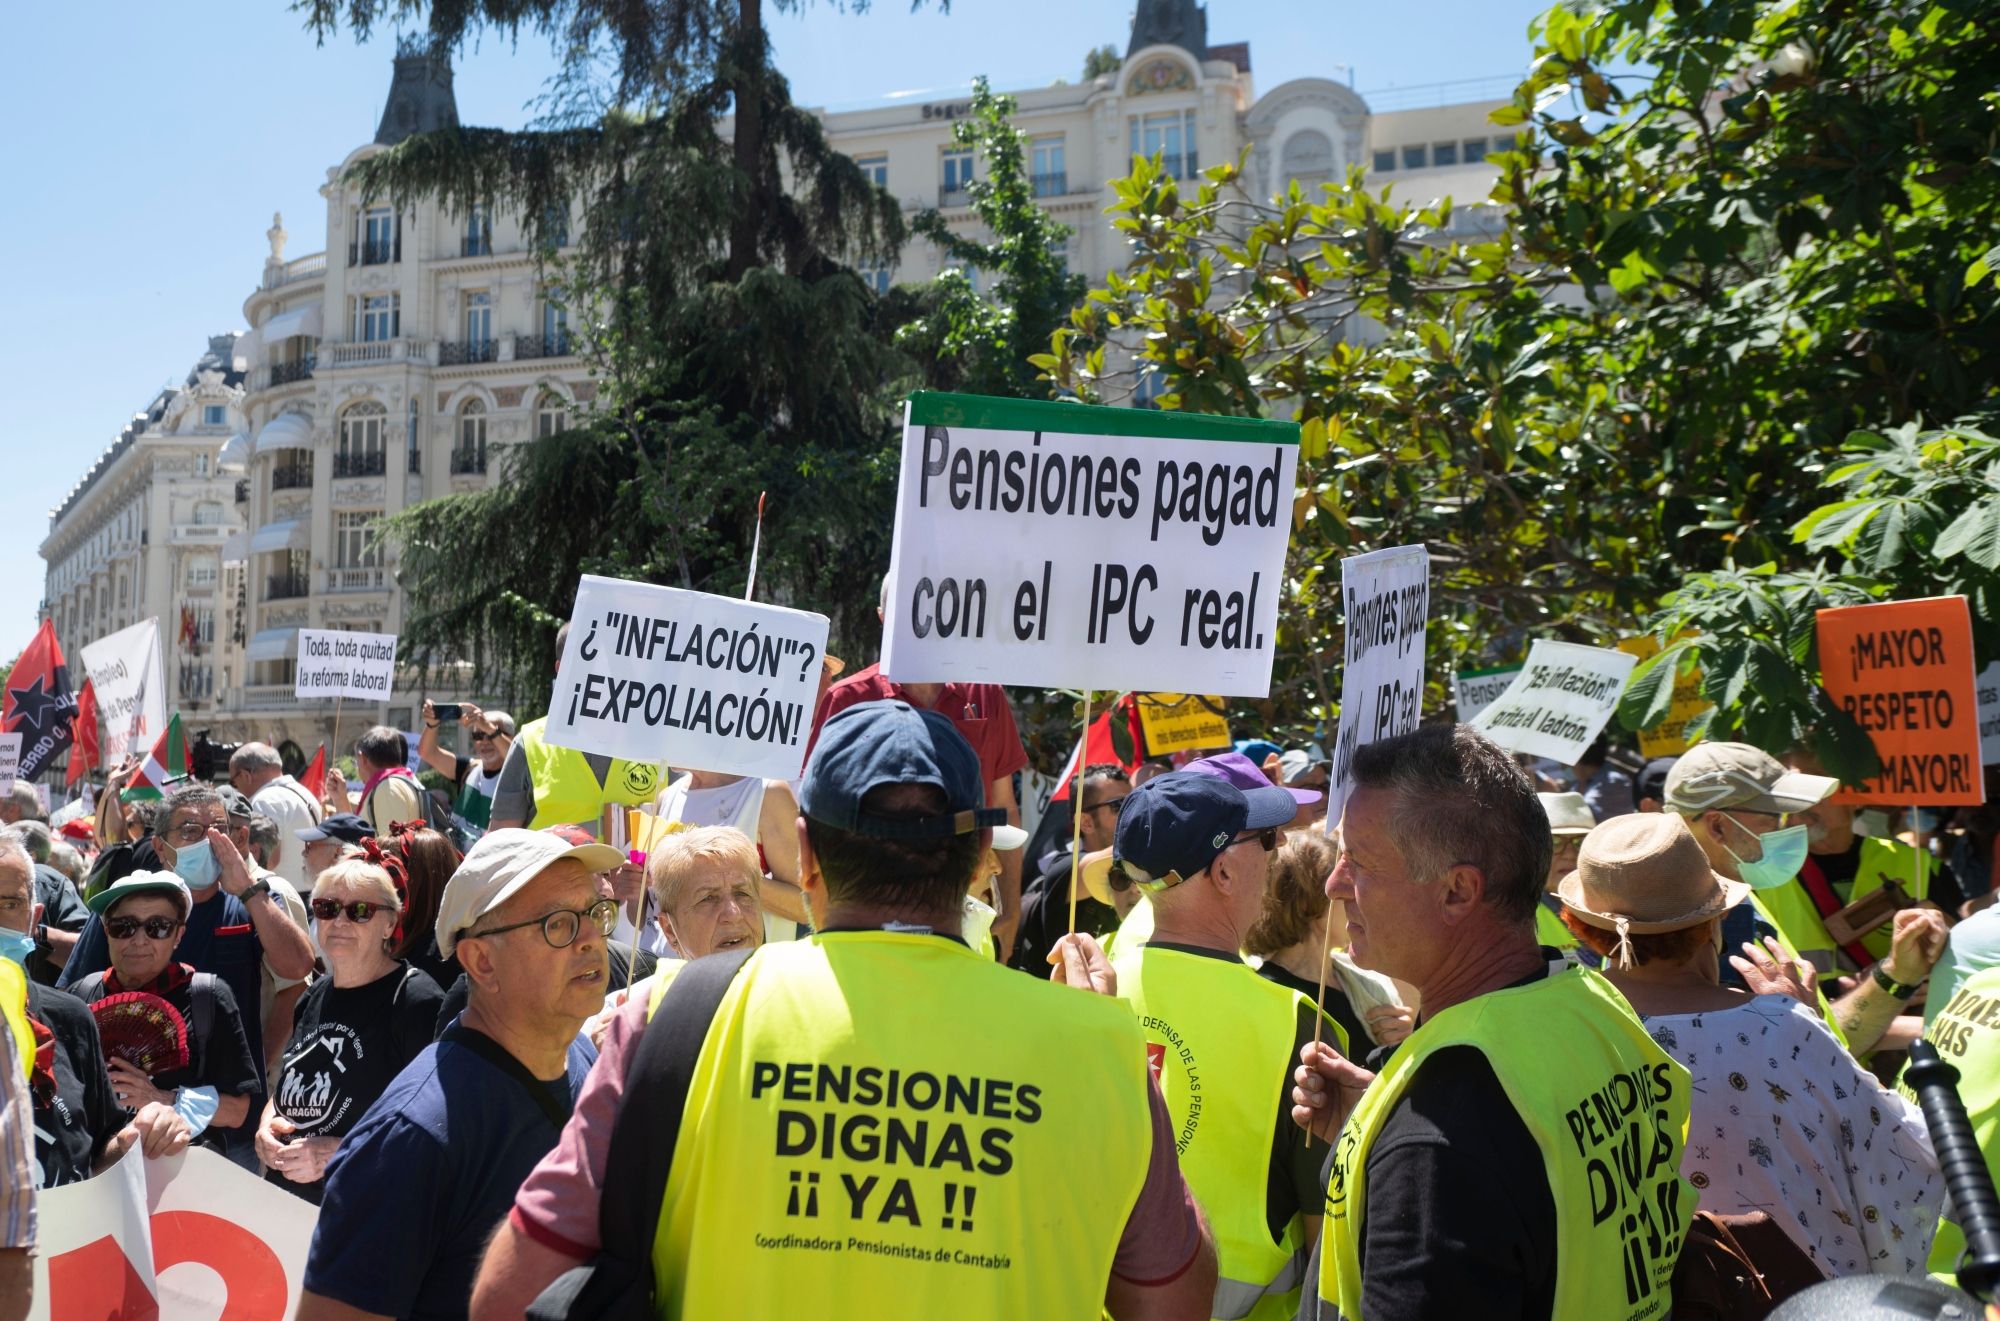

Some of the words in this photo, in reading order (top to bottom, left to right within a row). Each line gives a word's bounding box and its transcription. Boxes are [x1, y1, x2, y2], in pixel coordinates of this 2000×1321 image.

[920, 425, 1141, 519] Pensiones
[1151, 447, 1283, 546] pagad
[912, 576, 987, 639] con
[1013, 560, 1052, 641] el
[1087, 563, 1158, 646] IPC
[1180, 571, 1264, 650] real.
[305, 636, 332, 660] Toda,
[334, 638, 358, 658] toda
[360, 641, 394, 664] quitad
[1851, 627, 1946, 682] ¡MAYOR
[299, 667, 309, 688] la
[311, 667, 349, 687] reforma
[351, 668, 388, 691] laboral
[567, 673, 804, 746] ¡EXPOLIACIÓN!
[1843, 689, 1954, 732] RESPETO
[1142, 1016, 1184, 1050] DEFENSA
[1179, 1047, 1195, 1066] DE
[751, 1061, 1043, 1124] PENSIONES
[1186, 1066, 1201, 1092] LAS
[286, 1106, 322, 1117] ARAGÓN
[318, 1096, 353, 1135] Pensiones
[1176, 1095, 1202, 1156] PENSIONE
[776, 1110, 1014, 1176] DIGNAS
[840, 1173, 922, 1228] YA
[755, 1233, 842, 1251] Coordinadora
[848, 1237, 932, 1262] Pensionistas
[934, 1248, 951, 1262] de
